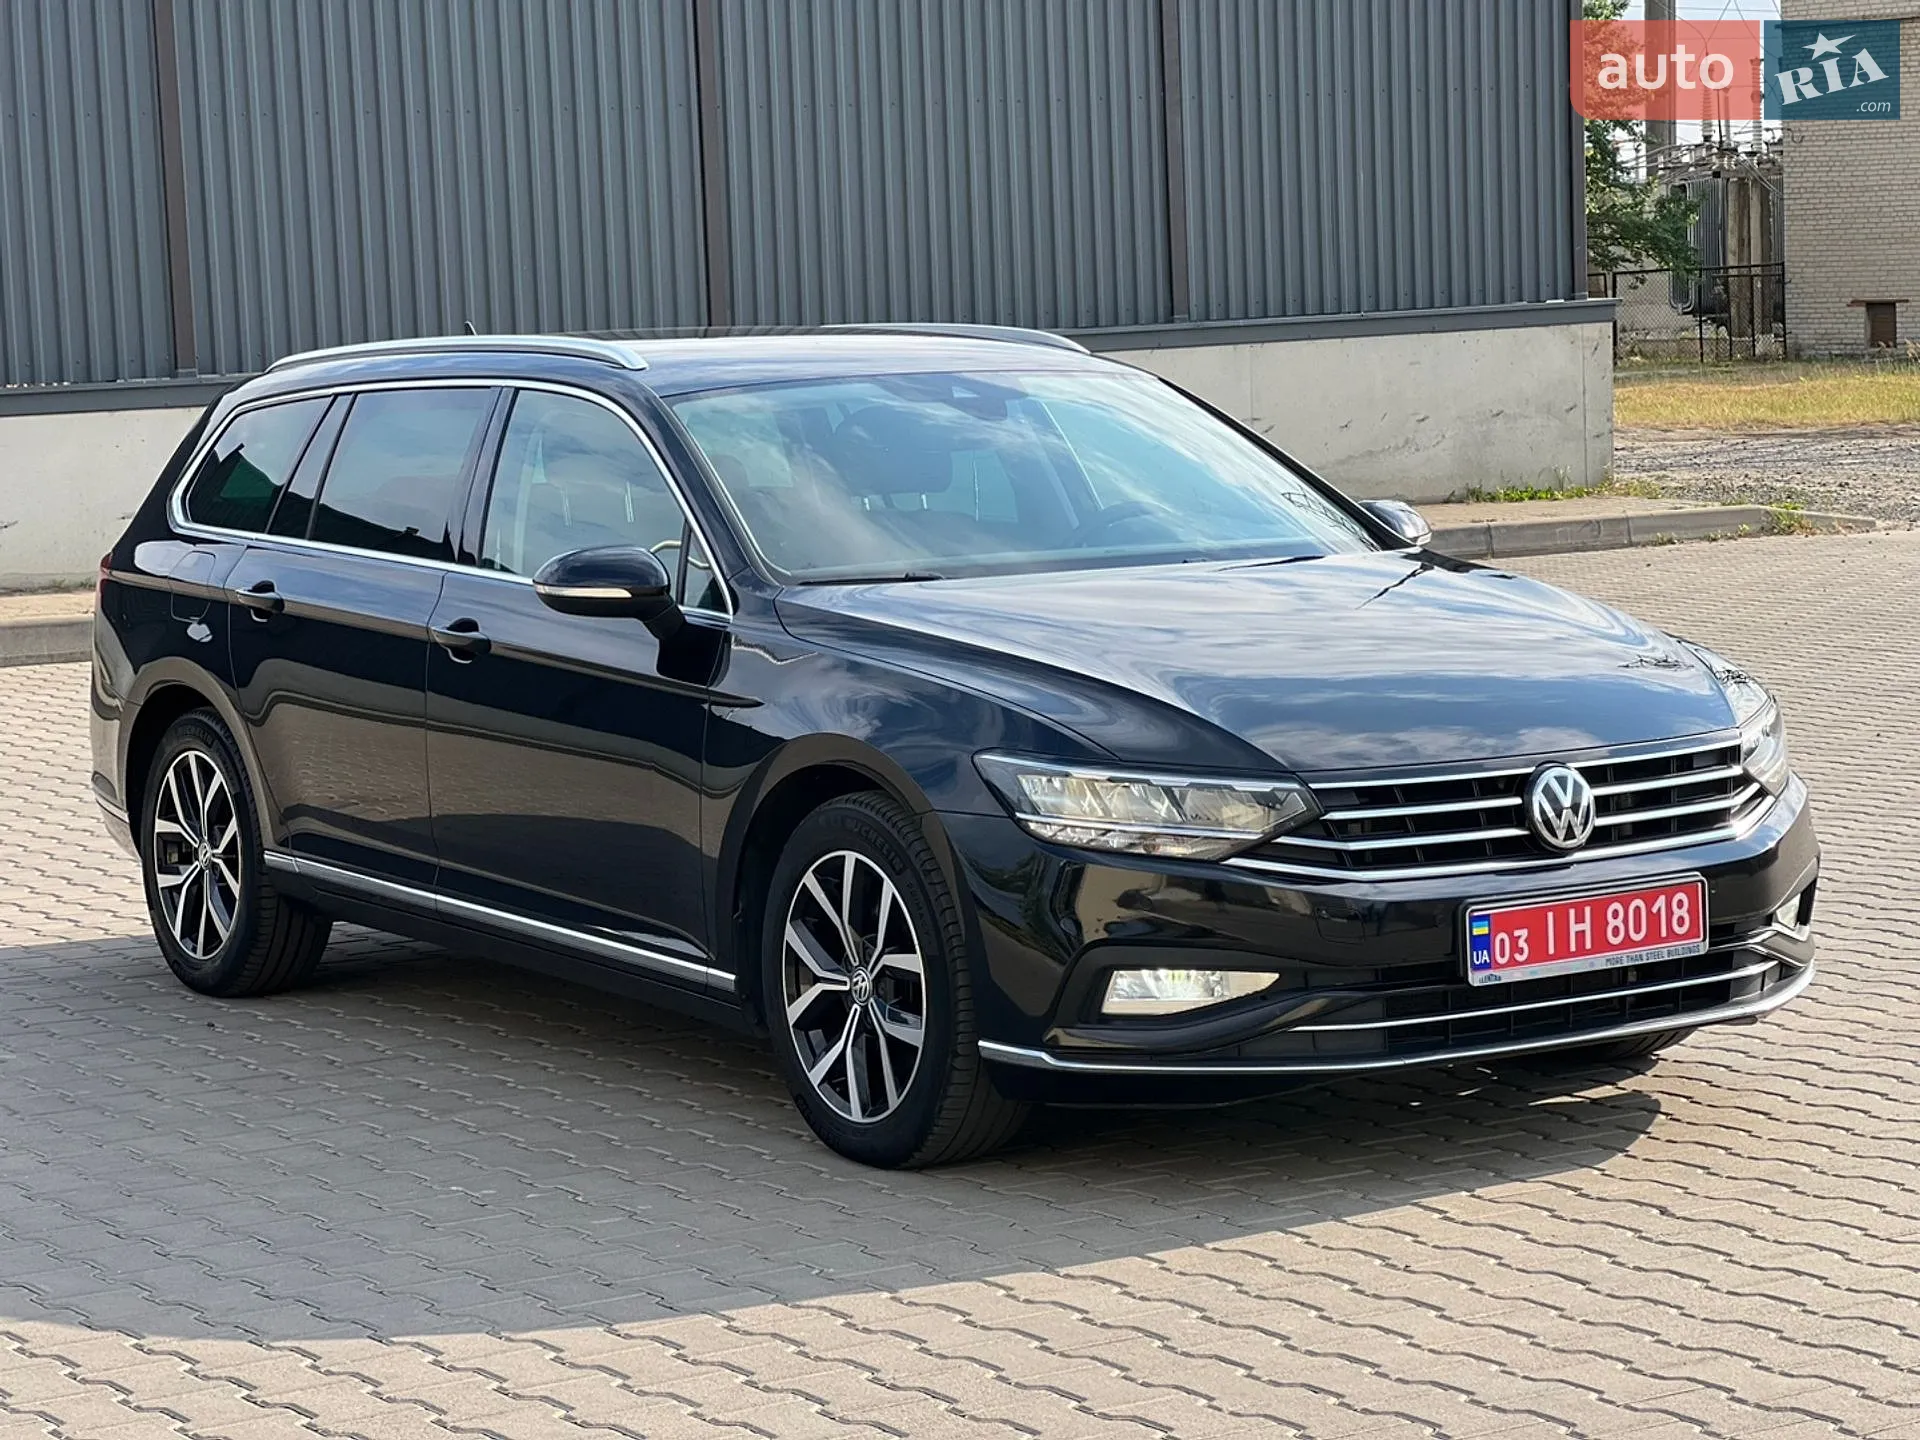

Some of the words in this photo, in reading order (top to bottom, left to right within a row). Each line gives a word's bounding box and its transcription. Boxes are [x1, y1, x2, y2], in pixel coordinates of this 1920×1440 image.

[1494, 928, 1530, 965] 03
[1606, 891, 1690, 945] 8018
[1473, 949, 1490, 965] UA
[1626, 953, 1644, 964] THAN
[1646, 950, 1665, 961] STEEL
[1667, 944, 1700, 959] BUILDINGS
